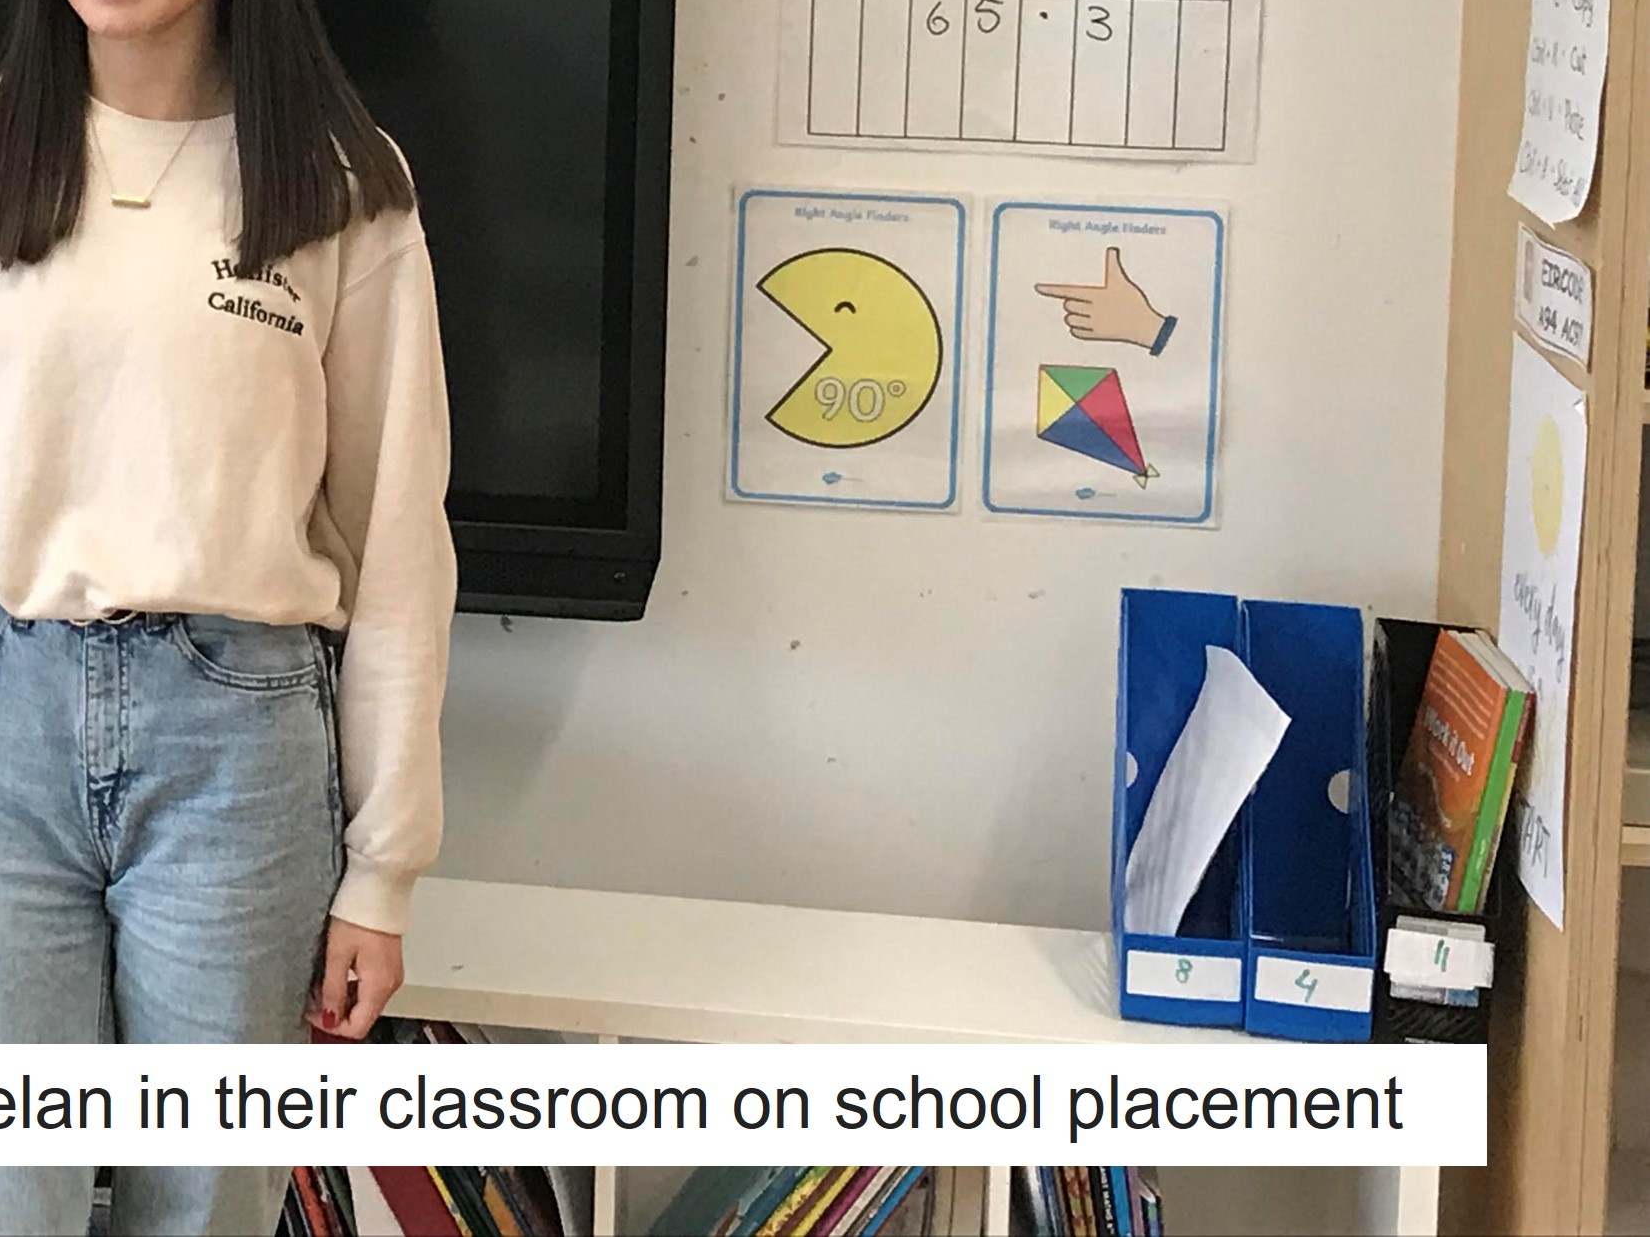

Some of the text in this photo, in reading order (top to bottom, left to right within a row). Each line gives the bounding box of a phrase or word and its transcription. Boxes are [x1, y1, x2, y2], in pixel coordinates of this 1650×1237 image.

[926, 1, 950, 35] 6
[1085, 6, 1113, 41] 3
[794, 207, 910, 222] Right Angle Finders
[1049, 219, 1167, 235] Right Angle Finders
[211, 259, 301, 303] Hlister
[208, 292, 304, 336] California
[814, 376, 907, 423] 90°
[1174, 958, 1193, 984] 8
[1295, 970, 1318, 1002] 4
